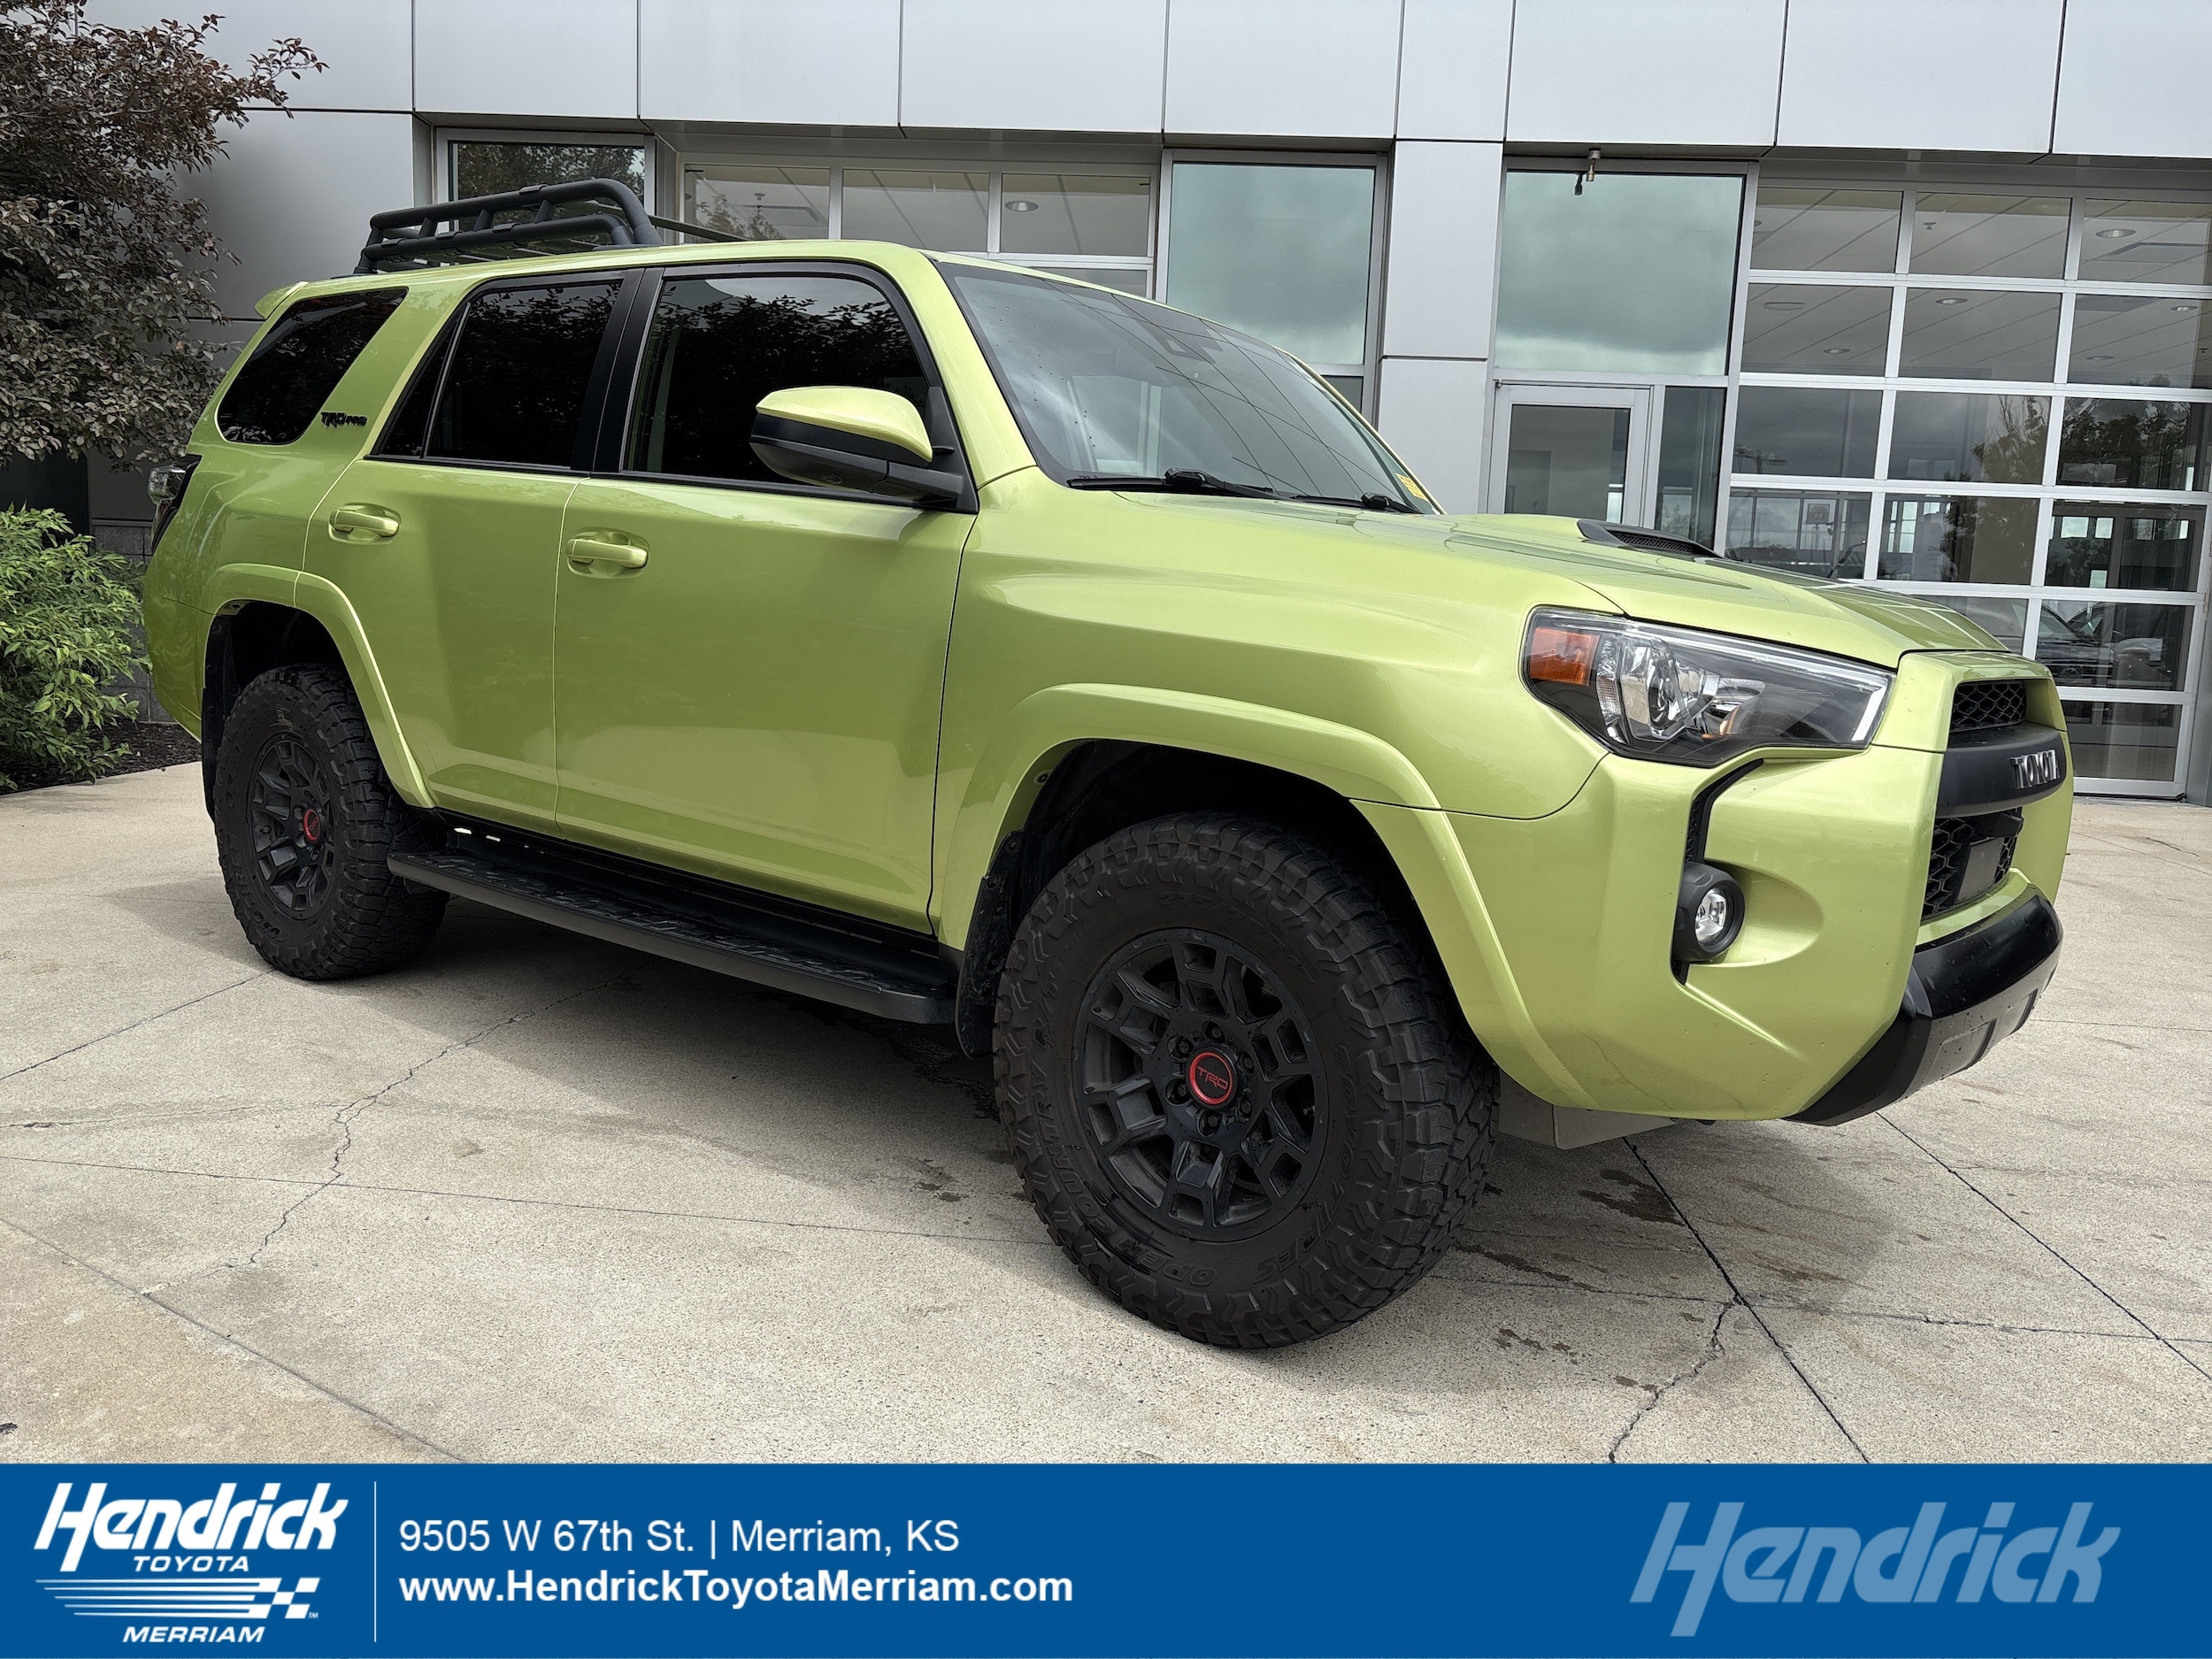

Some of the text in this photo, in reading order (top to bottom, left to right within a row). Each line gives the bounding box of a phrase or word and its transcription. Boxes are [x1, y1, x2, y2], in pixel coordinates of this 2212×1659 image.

[1196, 1065, 1229, 1090] TRD
[1030, 1058, 1119, 1236] COUNTRY
[1253, 1042, 1360, 1285] TOYO TIRES
[1117, 1236, 1217, 1286] OPEN
